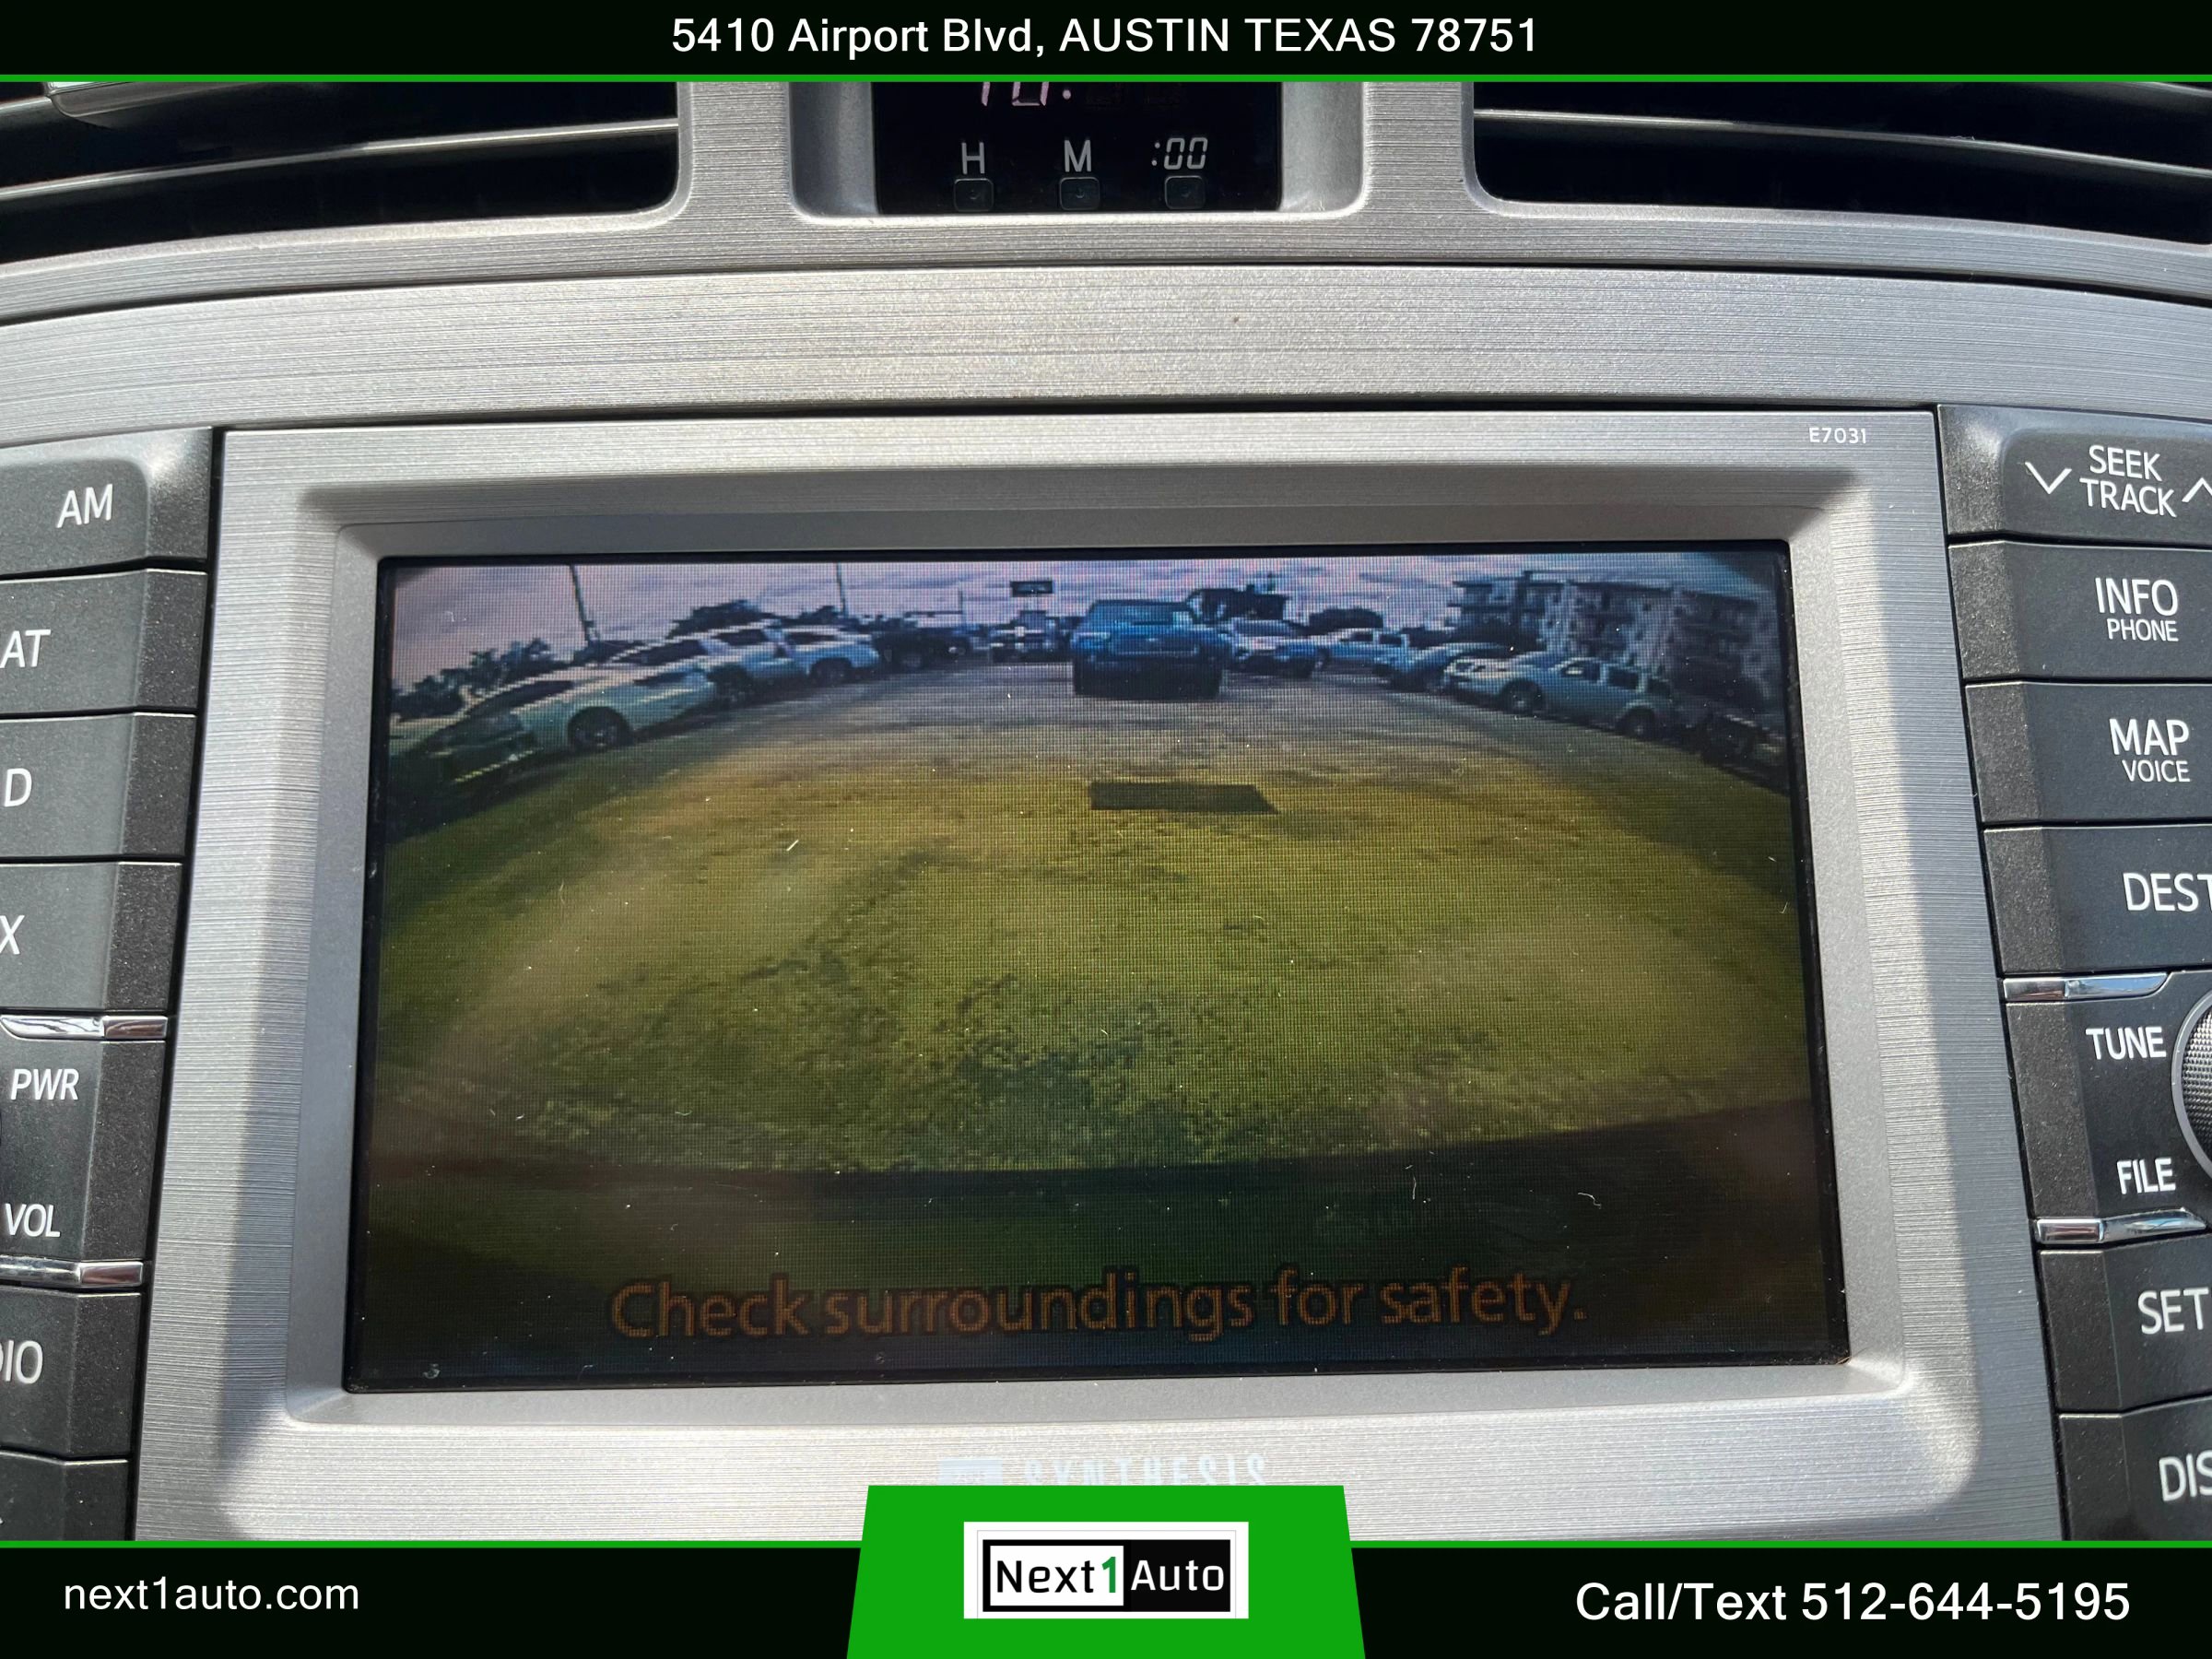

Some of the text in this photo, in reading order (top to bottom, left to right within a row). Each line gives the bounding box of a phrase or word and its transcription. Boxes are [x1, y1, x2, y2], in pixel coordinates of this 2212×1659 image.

[961, 142, 985, 175] H
[1064, 140, 1092, 173] M
[1152, 138, 1208, 170] :00
[1808, 427, 1867, 445] E7031
[2088, 445, 2161, 482] SEEK
[56, 484, 113, 528] AM
[2079, 479, 2176, 518] TRACK
[2095, 578, 2179, 617] INFO
[2107, 618, 2179, 643] PHONE
[2110, 718, 2190, 756] MAP
[2122, 759, 2191, 783] VOICE
[2123, 872, 2212, 912] DEST
[2085, 1026, 2167, 1060] TUNE
[10, 1068, 80, 1100] PWR
[2116, 1158, 2176, 1195] FILE
[5, 1204, 61, 1238] VOL
[611, 1265, 1588, 1342] Check surroundings for safety.
[2137, 1287, 2210, 1335] SET
[0, 1339, 44, 1385] IO
